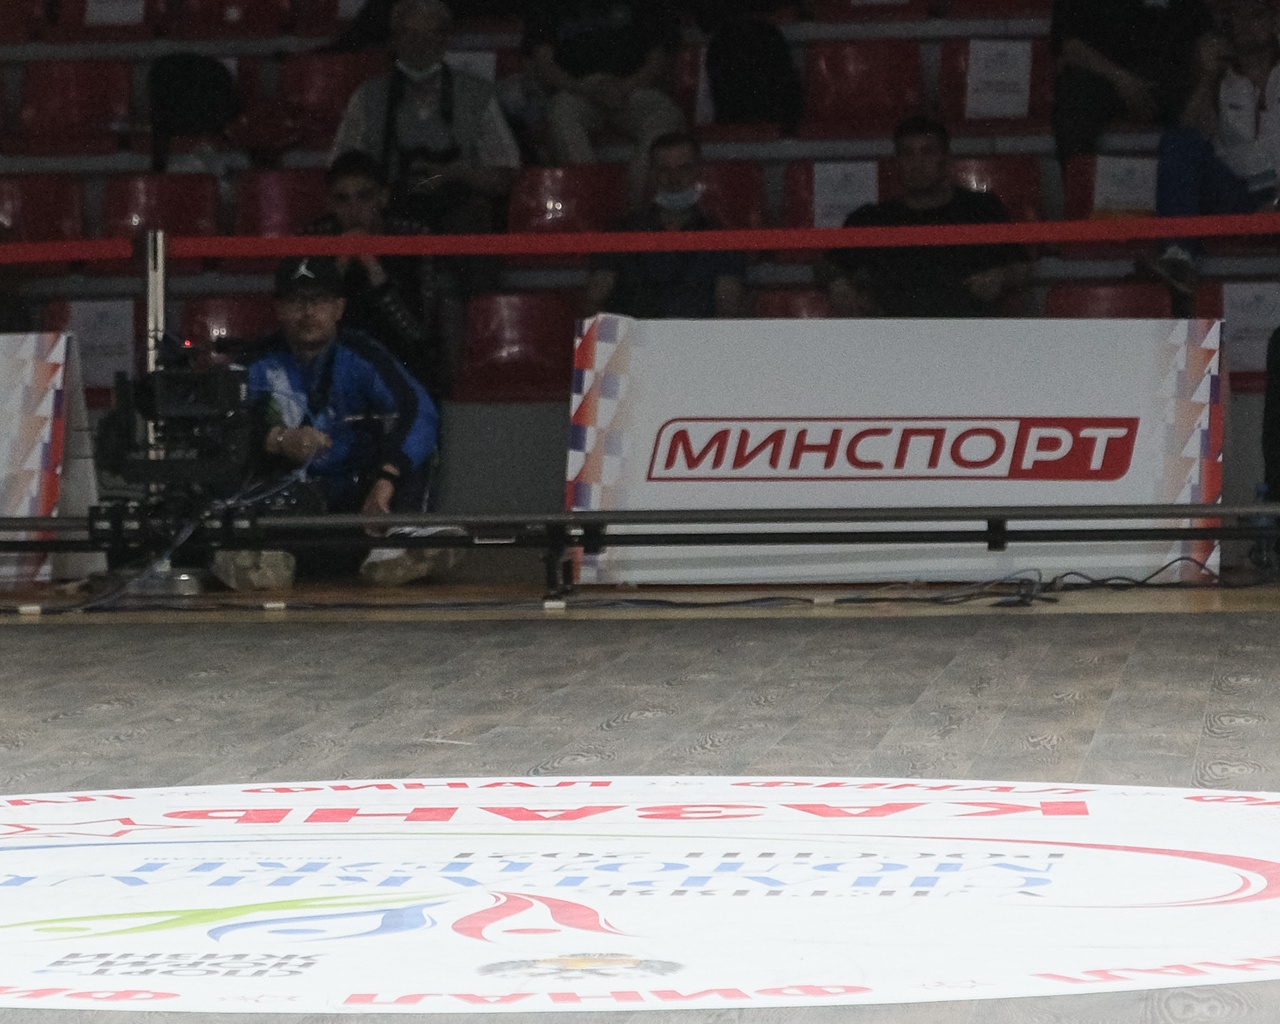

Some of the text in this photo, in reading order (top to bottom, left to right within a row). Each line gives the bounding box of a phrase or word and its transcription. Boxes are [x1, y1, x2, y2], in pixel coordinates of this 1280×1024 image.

[663, 426, 1129, 472] МИНСПОРТ
[163, 800, 1091, 825] КАЗАНЬ
[345, 985, 872, 1005] ФИНАЛ
